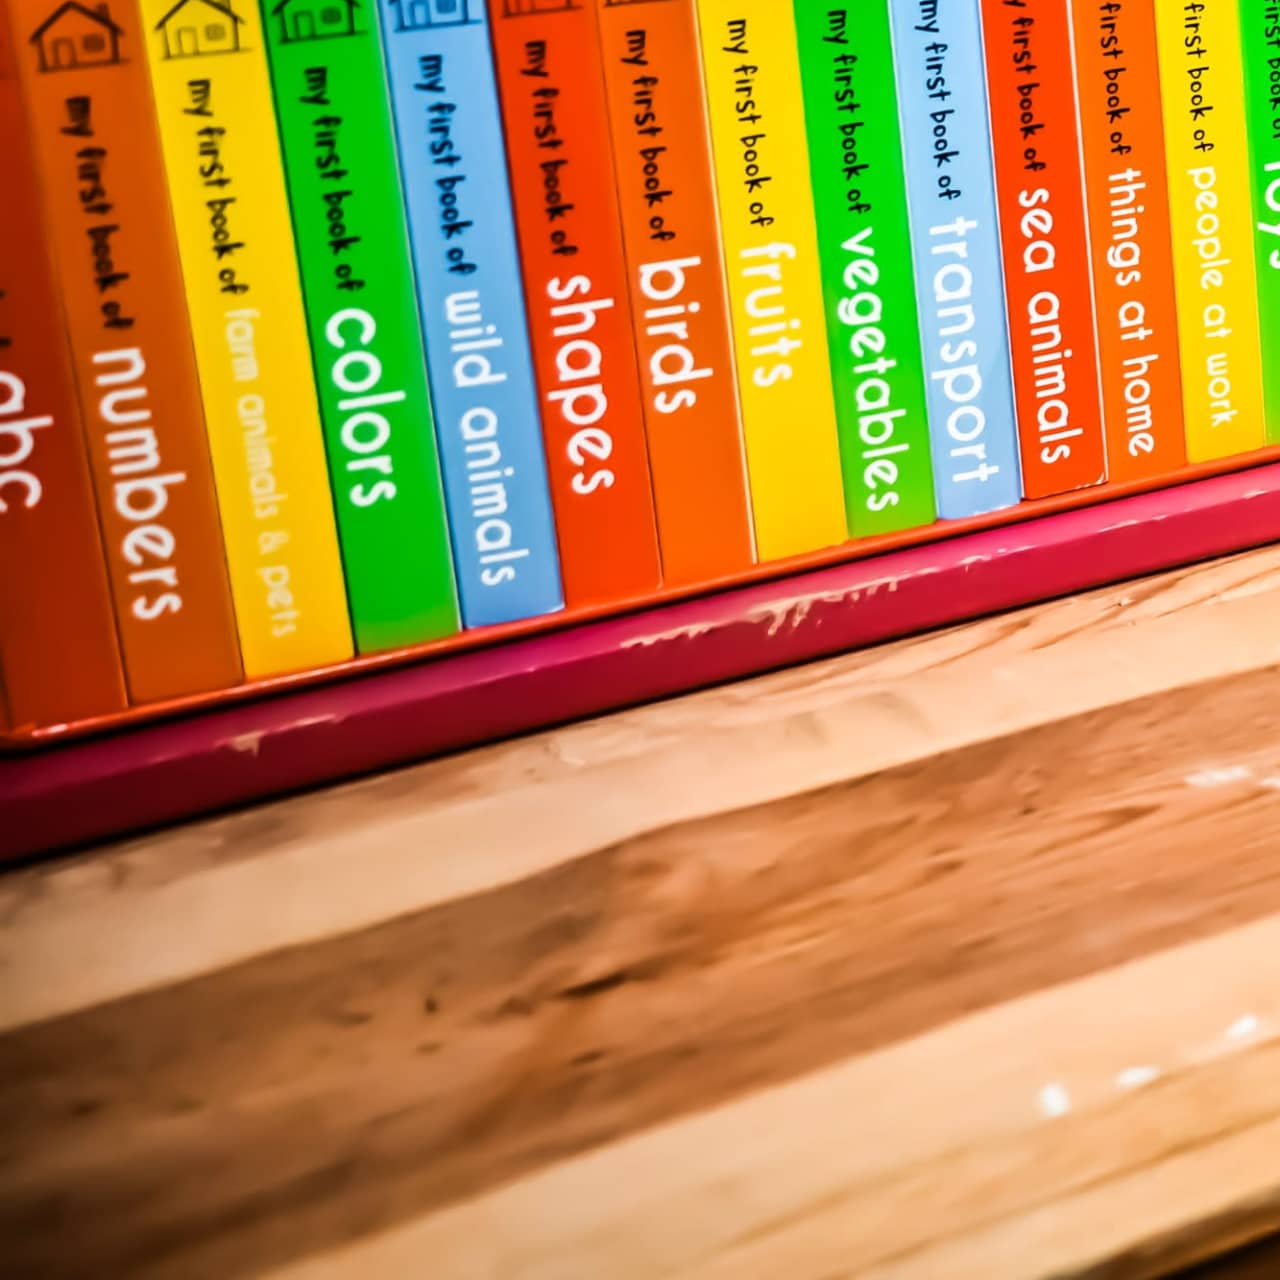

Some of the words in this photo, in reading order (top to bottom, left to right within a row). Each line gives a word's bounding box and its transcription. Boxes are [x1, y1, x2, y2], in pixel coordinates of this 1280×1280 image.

[622, 30, 647, 66] my
[722, 19, 748, 54] my
[823, 9, 849, 44] my
[1013, 17, 1037, 73] first
[1099, 2, 1123, 58] first
[1183, 2, 1207, 58] first
[301, 67, 329, 105] my
[415, 54, 444, 92] my
[519, 40, 548, 78] my
[833, 54, 860, 113] first
[924, 42, 952, 101] first
[60, 96, 90, 136] my
[182, 78, 212, 117] my
[534, 88, 562, 148] first
[633, 76, 662, 136] first
[733, 64, 762, 124] first
[1017, 82, 1045, 139] book
[1103, 67, 1131, 124] book
[1187, 66, 1214, 121] book
[198, 127, 230, 187] first
[314, 116, 347, 179] first
[428, 103, 461, 165] first
[740, 133, 772, 194] book
[839, 121, 869, 181] book
[929, 109, 960, 168] book
[1024, 148, 1046, 171] of
[1110, 131, 1132, 155] of
[1193, 129, 1215, 153] of
[78, 148, 111, 214] first
[436, 175, 473, 239] book
[540, 159, 574, 221] book
[639, 146, 673, 208] book
[847, 189, 871, 213] of
[938, 175, 962, 200] of
[206, 197, 245, 260] book
[322, 190, 361, 255] book
[551, 231, 577, 255] of
[650, 216, 675, 240] of
[749, 202, 774, 227] of
[1019, 189, 1055, 272] sea
[1107, 169, 1145, 286] things
[1188, 167, 1230, 289] people
[87, 225, 129, 292] book
[219, 269, 248, 293] of
[335, 264, 364, 290] of
[447, 247, 476, 273] of
[102, 302, 133, 328] of
[446, 291, 506, 387] wild
[640, 257, 713, 413] birds
[741, 242, 802, 386] fruits
[1119, 301, 1152, 340] at
[1204, 304, 1232, 337] at
[227, 309, 258, 380] farm
[837, 227, 909, 511] vegetables
[929, 217, 1000, 482] transport
[326, 309, 405, 506] colors
[547, 276, 614, 494] shapes
[1028, 292, 1083, 463] animals
[1123, 354, 1158, 456] home
[1207, 353, 1237, 426] work
[93, 348, 185, 619] numbers
[238, 394, 285, 518] animals
[460, 407, 529, 585] animals
[261, 566, 297, 636] pets
